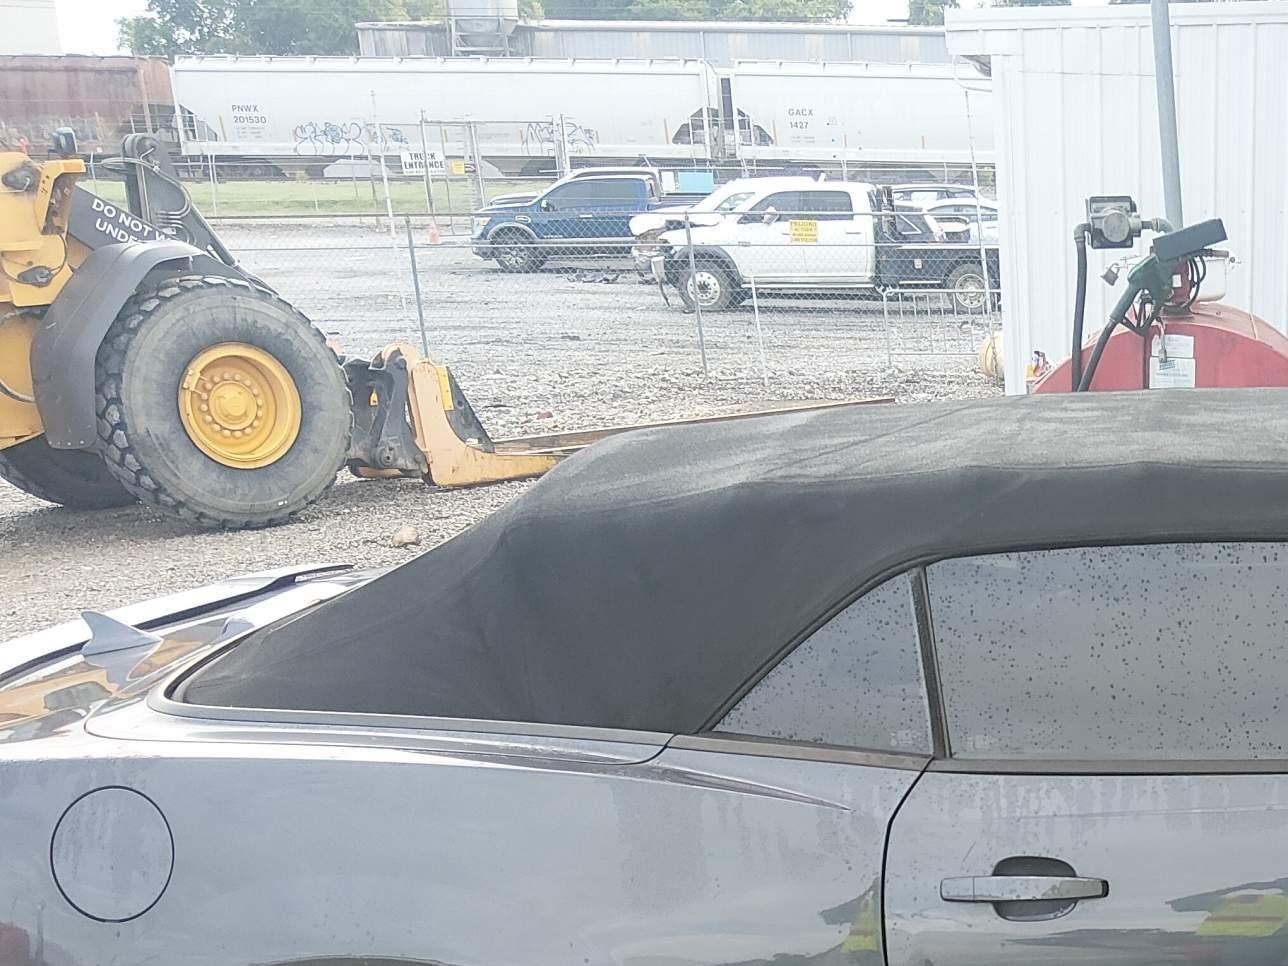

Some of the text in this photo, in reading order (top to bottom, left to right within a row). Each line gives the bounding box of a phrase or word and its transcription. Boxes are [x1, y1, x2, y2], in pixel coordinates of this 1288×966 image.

[232, 104, 258, 113] PNWX
[788, 108, 813, 117] GACX
[233, 115, 267, 124] 201530
[789, 121, 809, 130] 1427
[92, 198, 116, 218] DO
[118, 212, 153, 237] NOT
